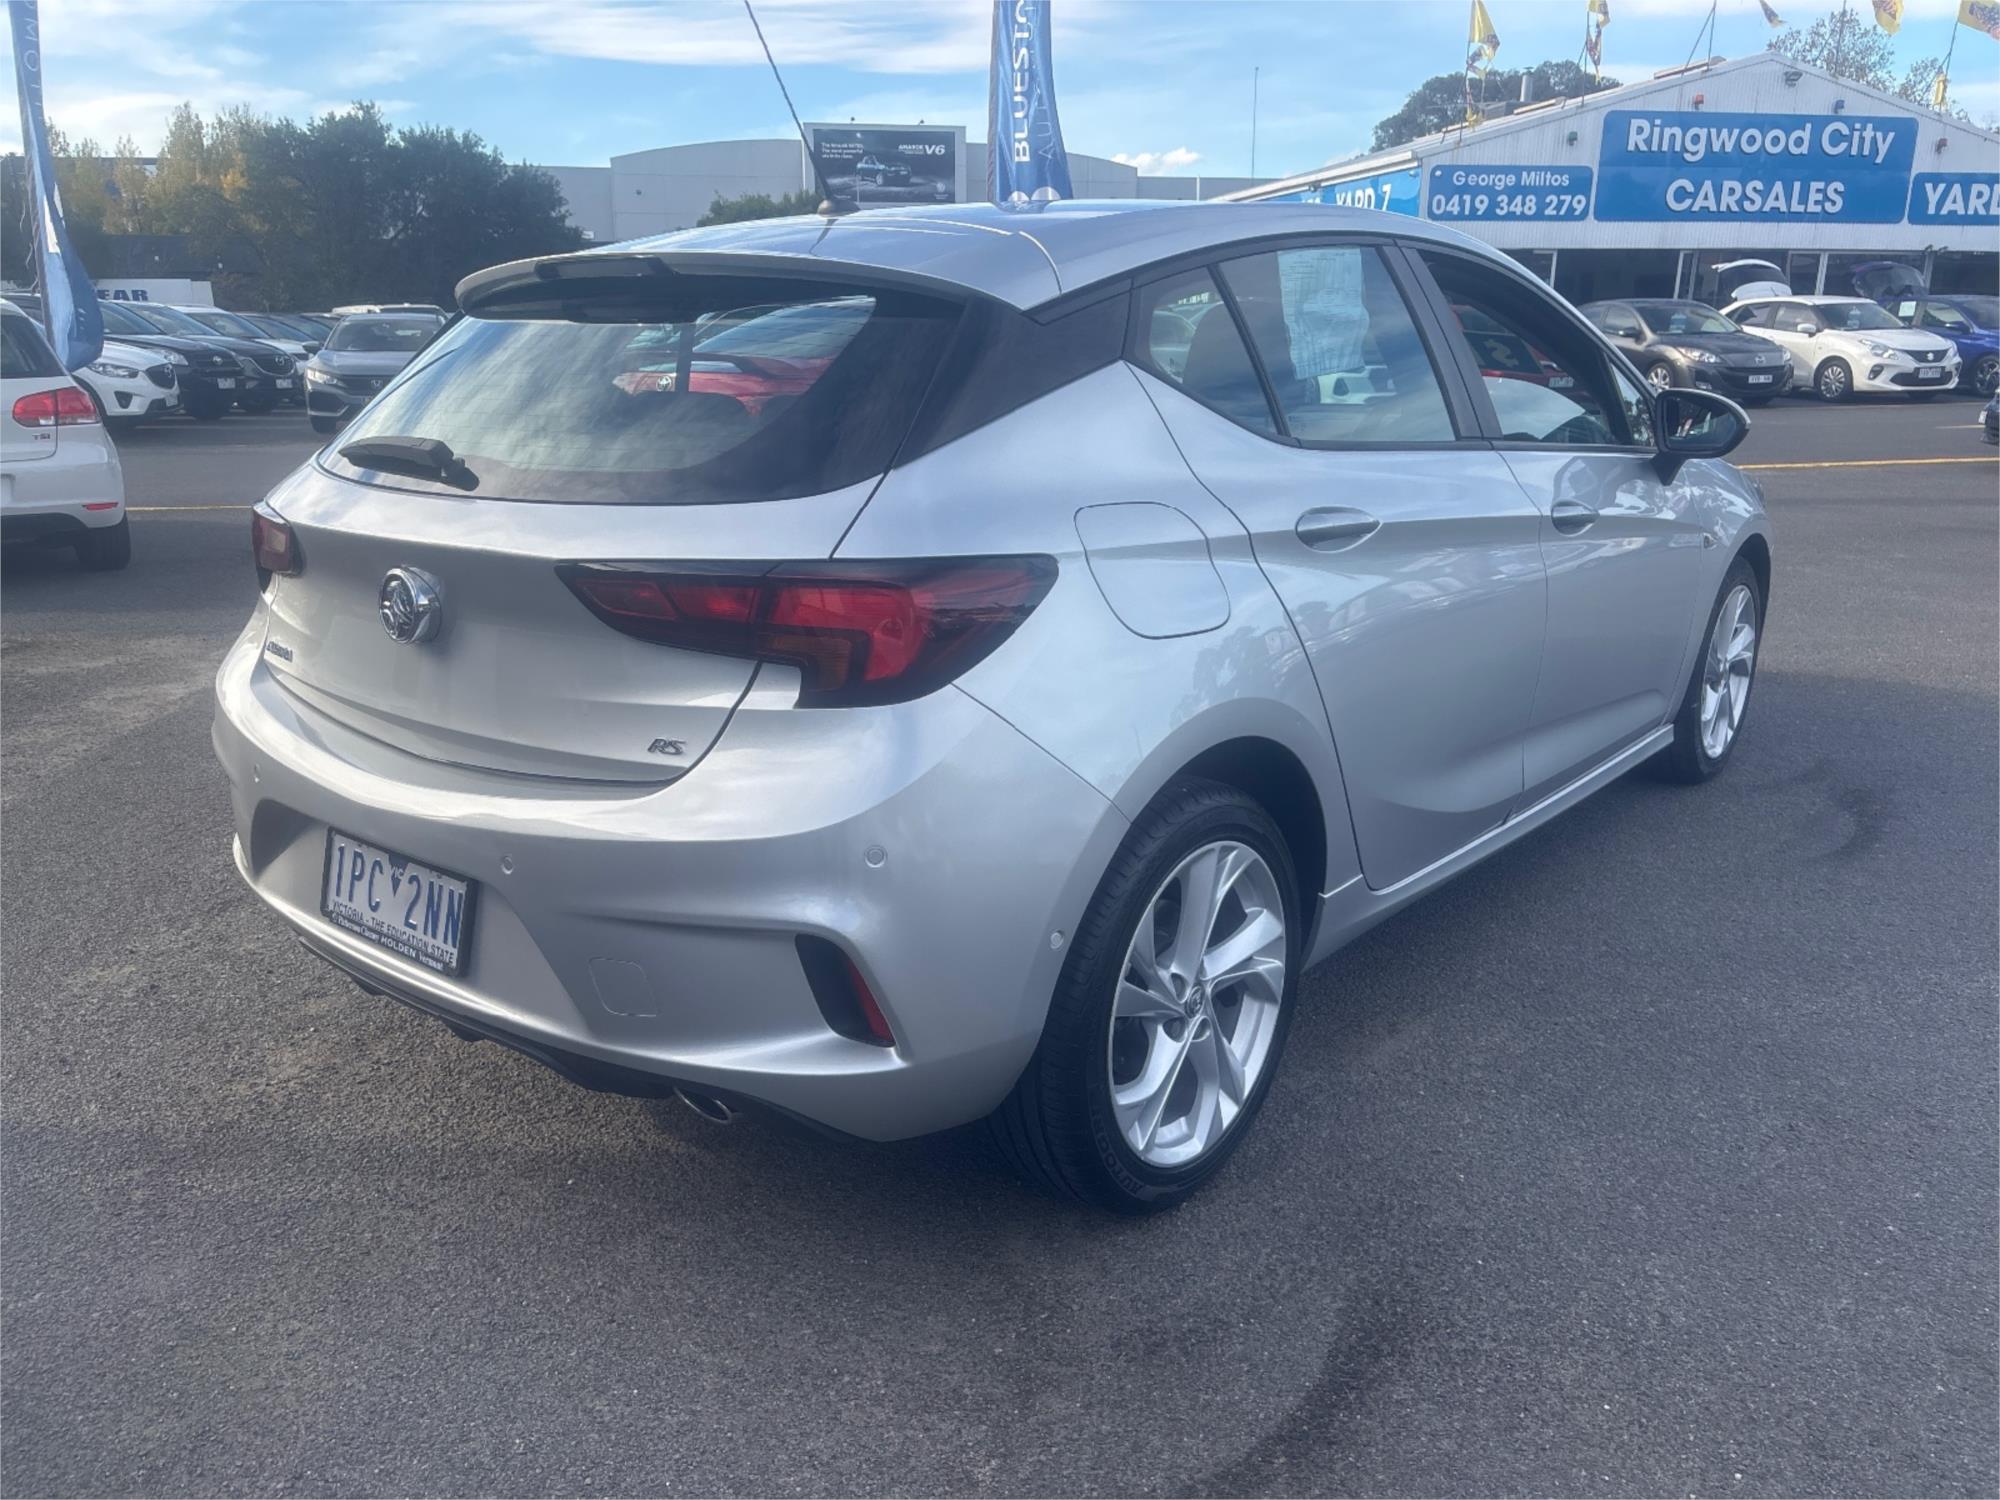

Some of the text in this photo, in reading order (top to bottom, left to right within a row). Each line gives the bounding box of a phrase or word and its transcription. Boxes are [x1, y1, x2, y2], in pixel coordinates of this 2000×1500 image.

[925, 144, 946, 155] V6
[1626, 119, 1896, 164] Ringwood City
[1453, 171, 1570, 190] George Miltos
[1382, 184, 1391, 211] 7
[1432, 194, 1587, 215] 0419 348 279
[1665, 179, 1845, 214] CARSALES
[647, 738, 687, 755] RS
[335, 843, 384, 913] 1PC
[403, 873, 464, 949] 2NN
[370, 916, 385, 932] THE
[430, 944, 455, 964] STATE
[380, 935, 417, 958] HOLDEN
